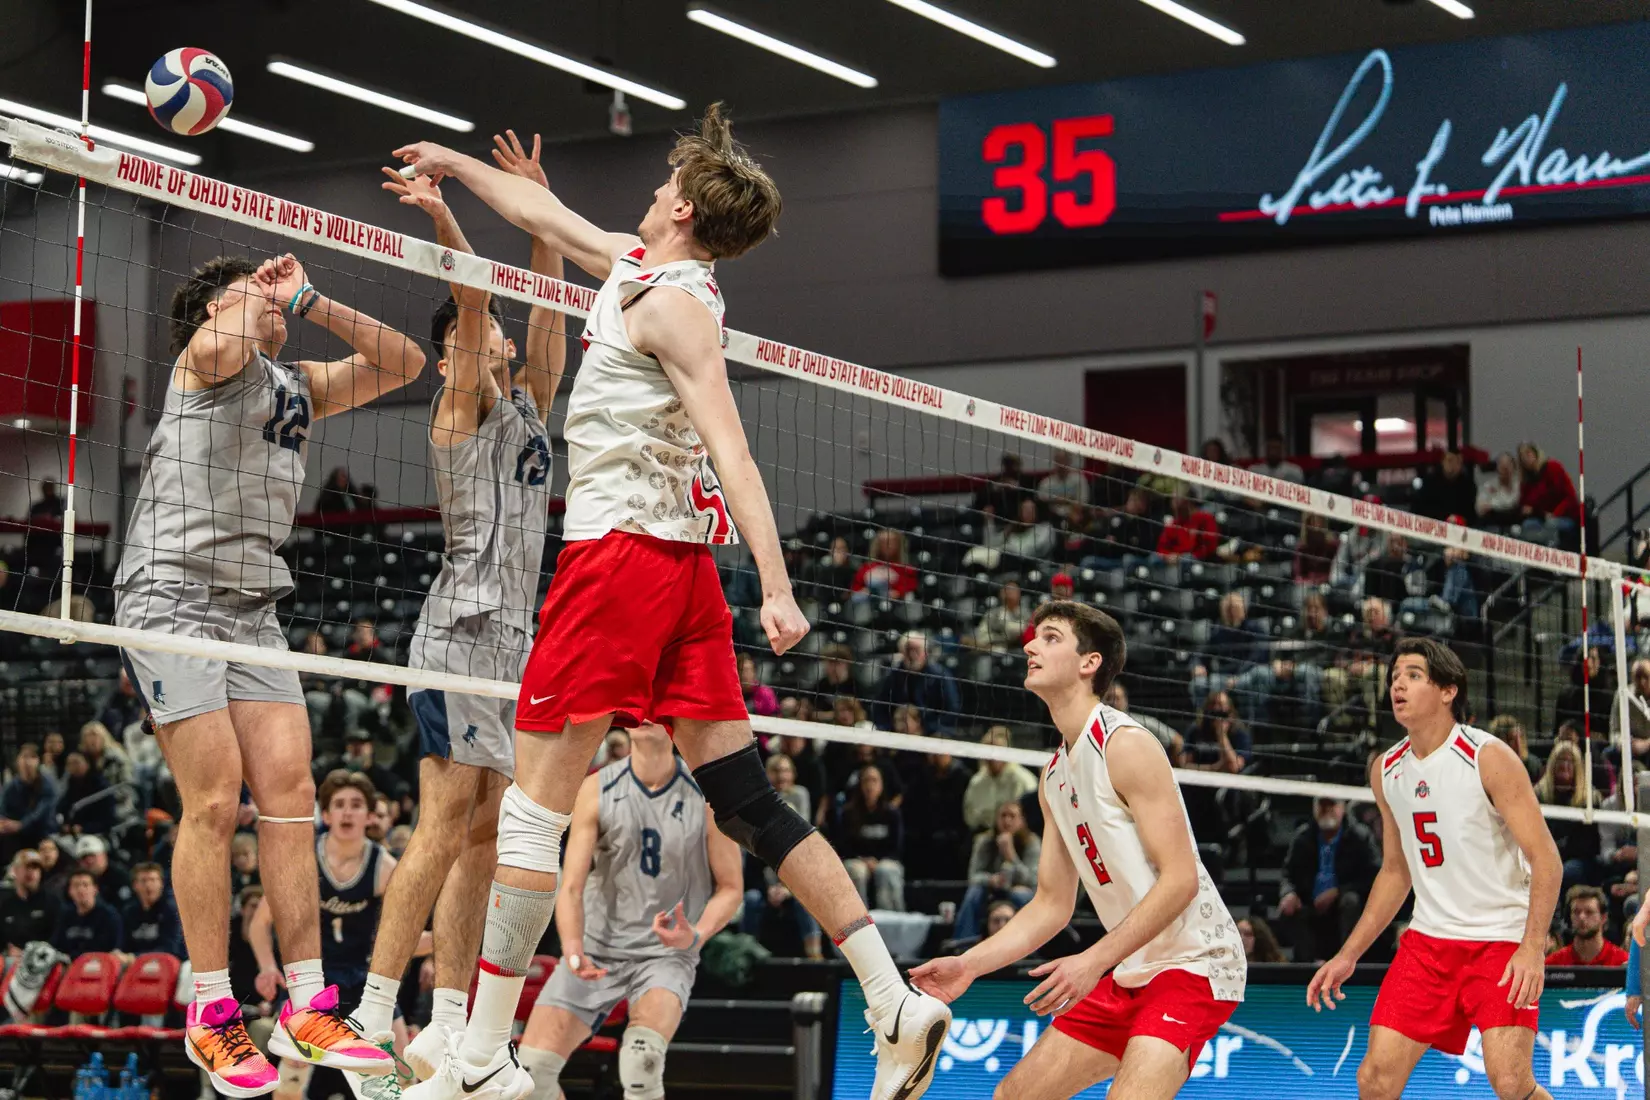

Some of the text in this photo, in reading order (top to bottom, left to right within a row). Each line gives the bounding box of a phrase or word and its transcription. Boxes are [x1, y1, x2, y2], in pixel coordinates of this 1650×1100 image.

[981, 113, 1116, 235] 35
[117, 152, 404, 259] HOME OF OHIO STATE MEN'S VOLLEYBALL
[490, 261, 562, 303] THREE-TIME
[756, 339, 944, 408] HOME OF OHIO STATE MEN'S VOLLEYBALL
[263, 383, 309, 454] 12
[1000, 406, 1135, 459] THREE-TIME NATIONAL CHAMPIONS
[1180, 454, 1201, 477] HOME
[1203, 460, 1213, 478] OF
[1213, 462, 1230, 484] OHIO
[1231, 466, 1251, 490] STATE
[1275, 478, 1312, 506] VOLLEYBALL
[640, 827, 661, 879] 8
[1076, 821, 1113, 886] 2
[1412, 810, 1445, 869] 5
[332, 916, 344, 943] 1
[1550, 998, 1643, 1088] Kr
